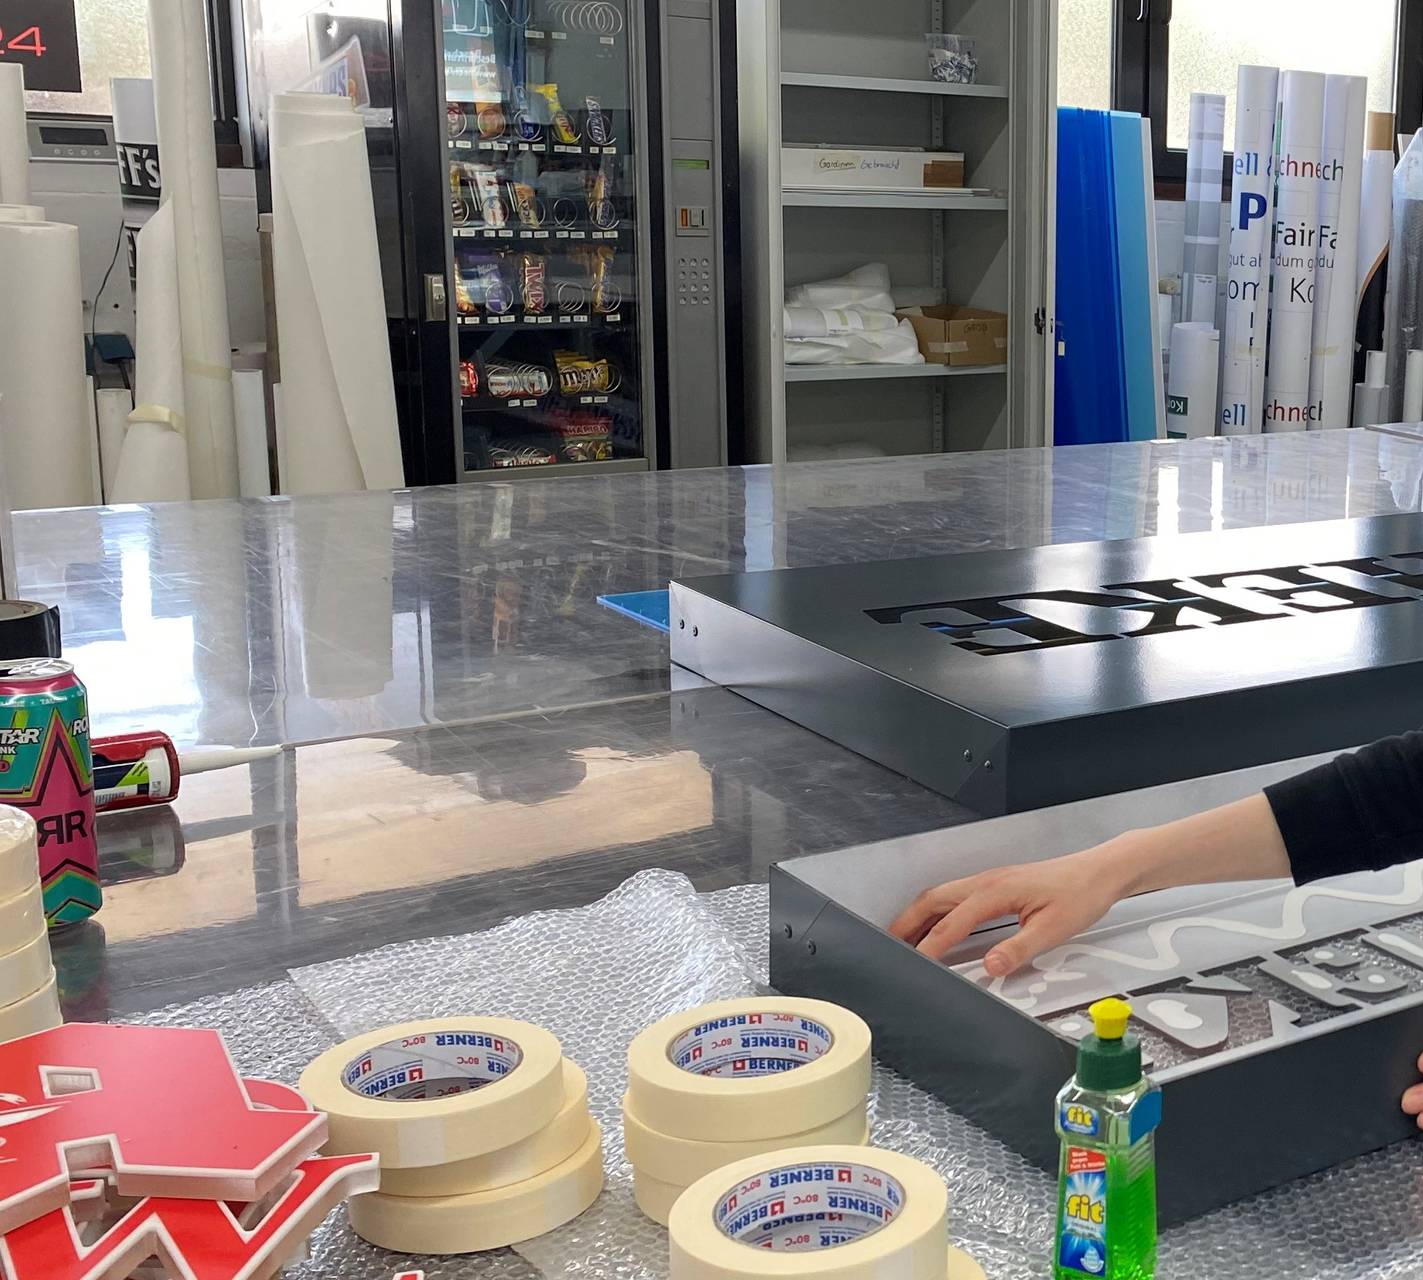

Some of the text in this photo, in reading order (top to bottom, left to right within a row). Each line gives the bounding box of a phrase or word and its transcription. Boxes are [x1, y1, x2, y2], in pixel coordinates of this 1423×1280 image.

[0, 27, 46, 57] 4
[1239, 192, 1267, 230] P
[694, 1015, 746, 1037] BERNER
[402, 1036, 426, 1048] 80°C
[435, 1034, 493, 1048] BERNER
[711, 1037, 733, 1049] 80°C
[740, 1035, 796, 1049] BERNER
[456, 1056, 479, 1065] 80°C
[1067, 1105, 1092, 1127] fit
[769, 1168, 834, 1188] BERNER
[793, 1194, 818, 1204] 80°C
[827, 1196, 883, 1217] BERNER
[1067, 1195, 1104, 1223] fit
[785, 1234, 810, 1246] 80°C
